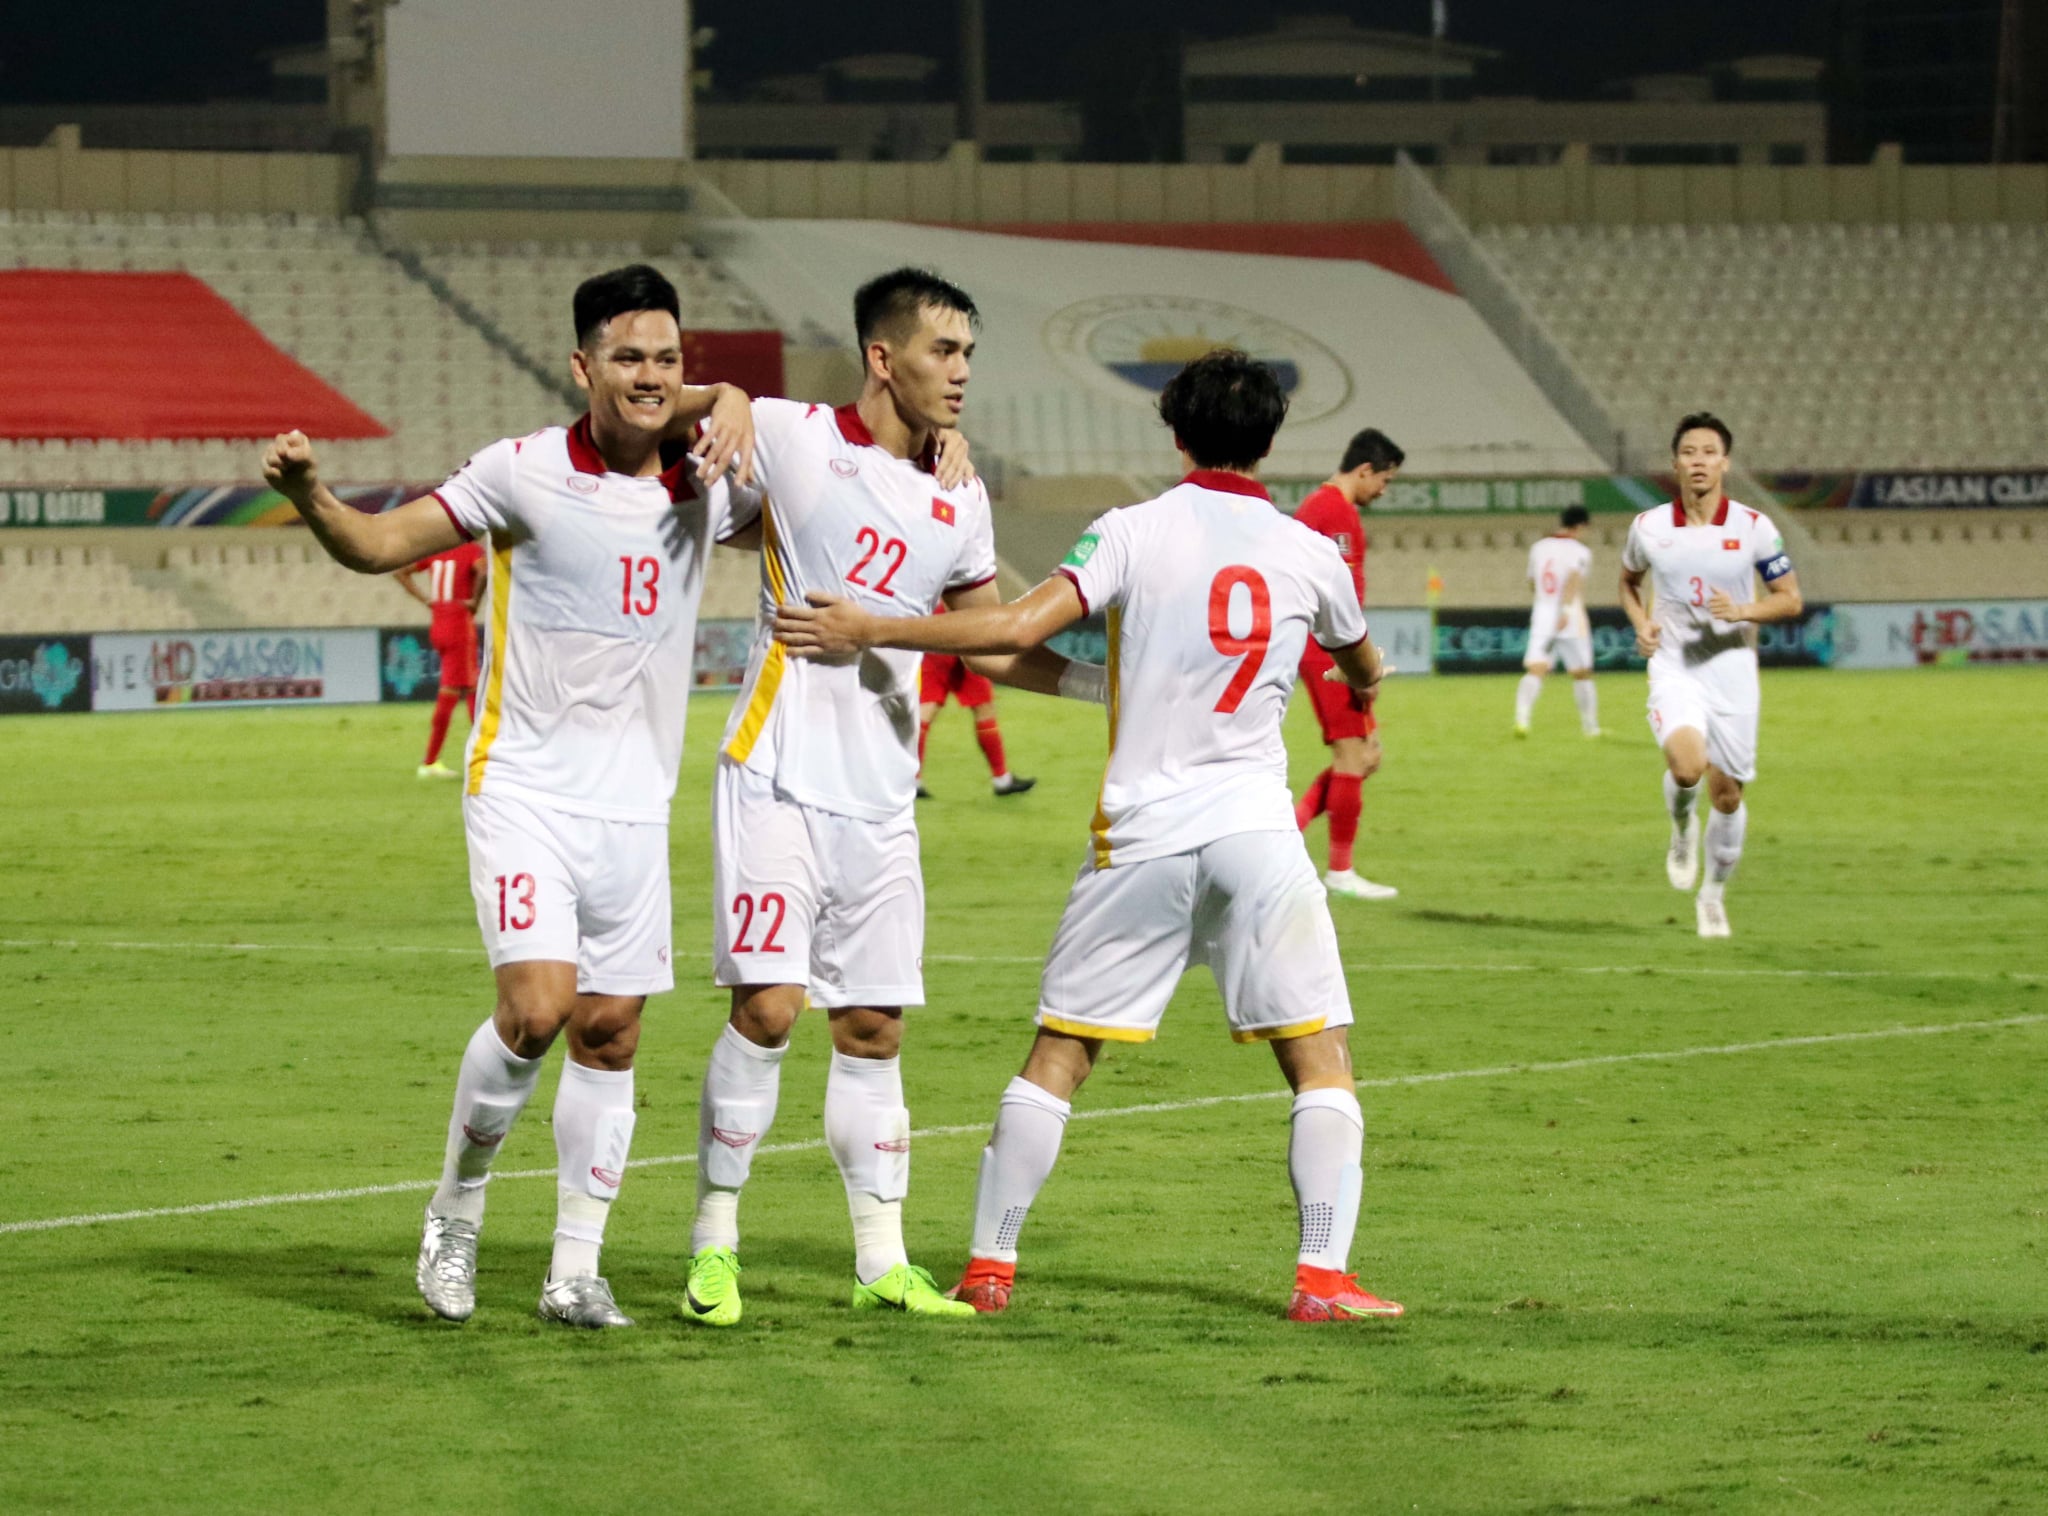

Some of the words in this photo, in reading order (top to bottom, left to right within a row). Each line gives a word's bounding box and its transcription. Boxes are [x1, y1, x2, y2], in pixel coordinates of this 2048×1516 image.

[1888, 475, 1986, 503] ASIAN
[431, 559, 456, 602] 11
[619, 555, 661, 617] 13
[846, 527, 908, 598] 22
[1542, 558, 1558, 595] 6
[1689, 576, 1704, 607] 3
[202, 637, 325, 681] SAISON
[1208, 564, 1272, 714] 9
[495, 871, 536, 933] 13
[730, 892, 787, 954] 22
